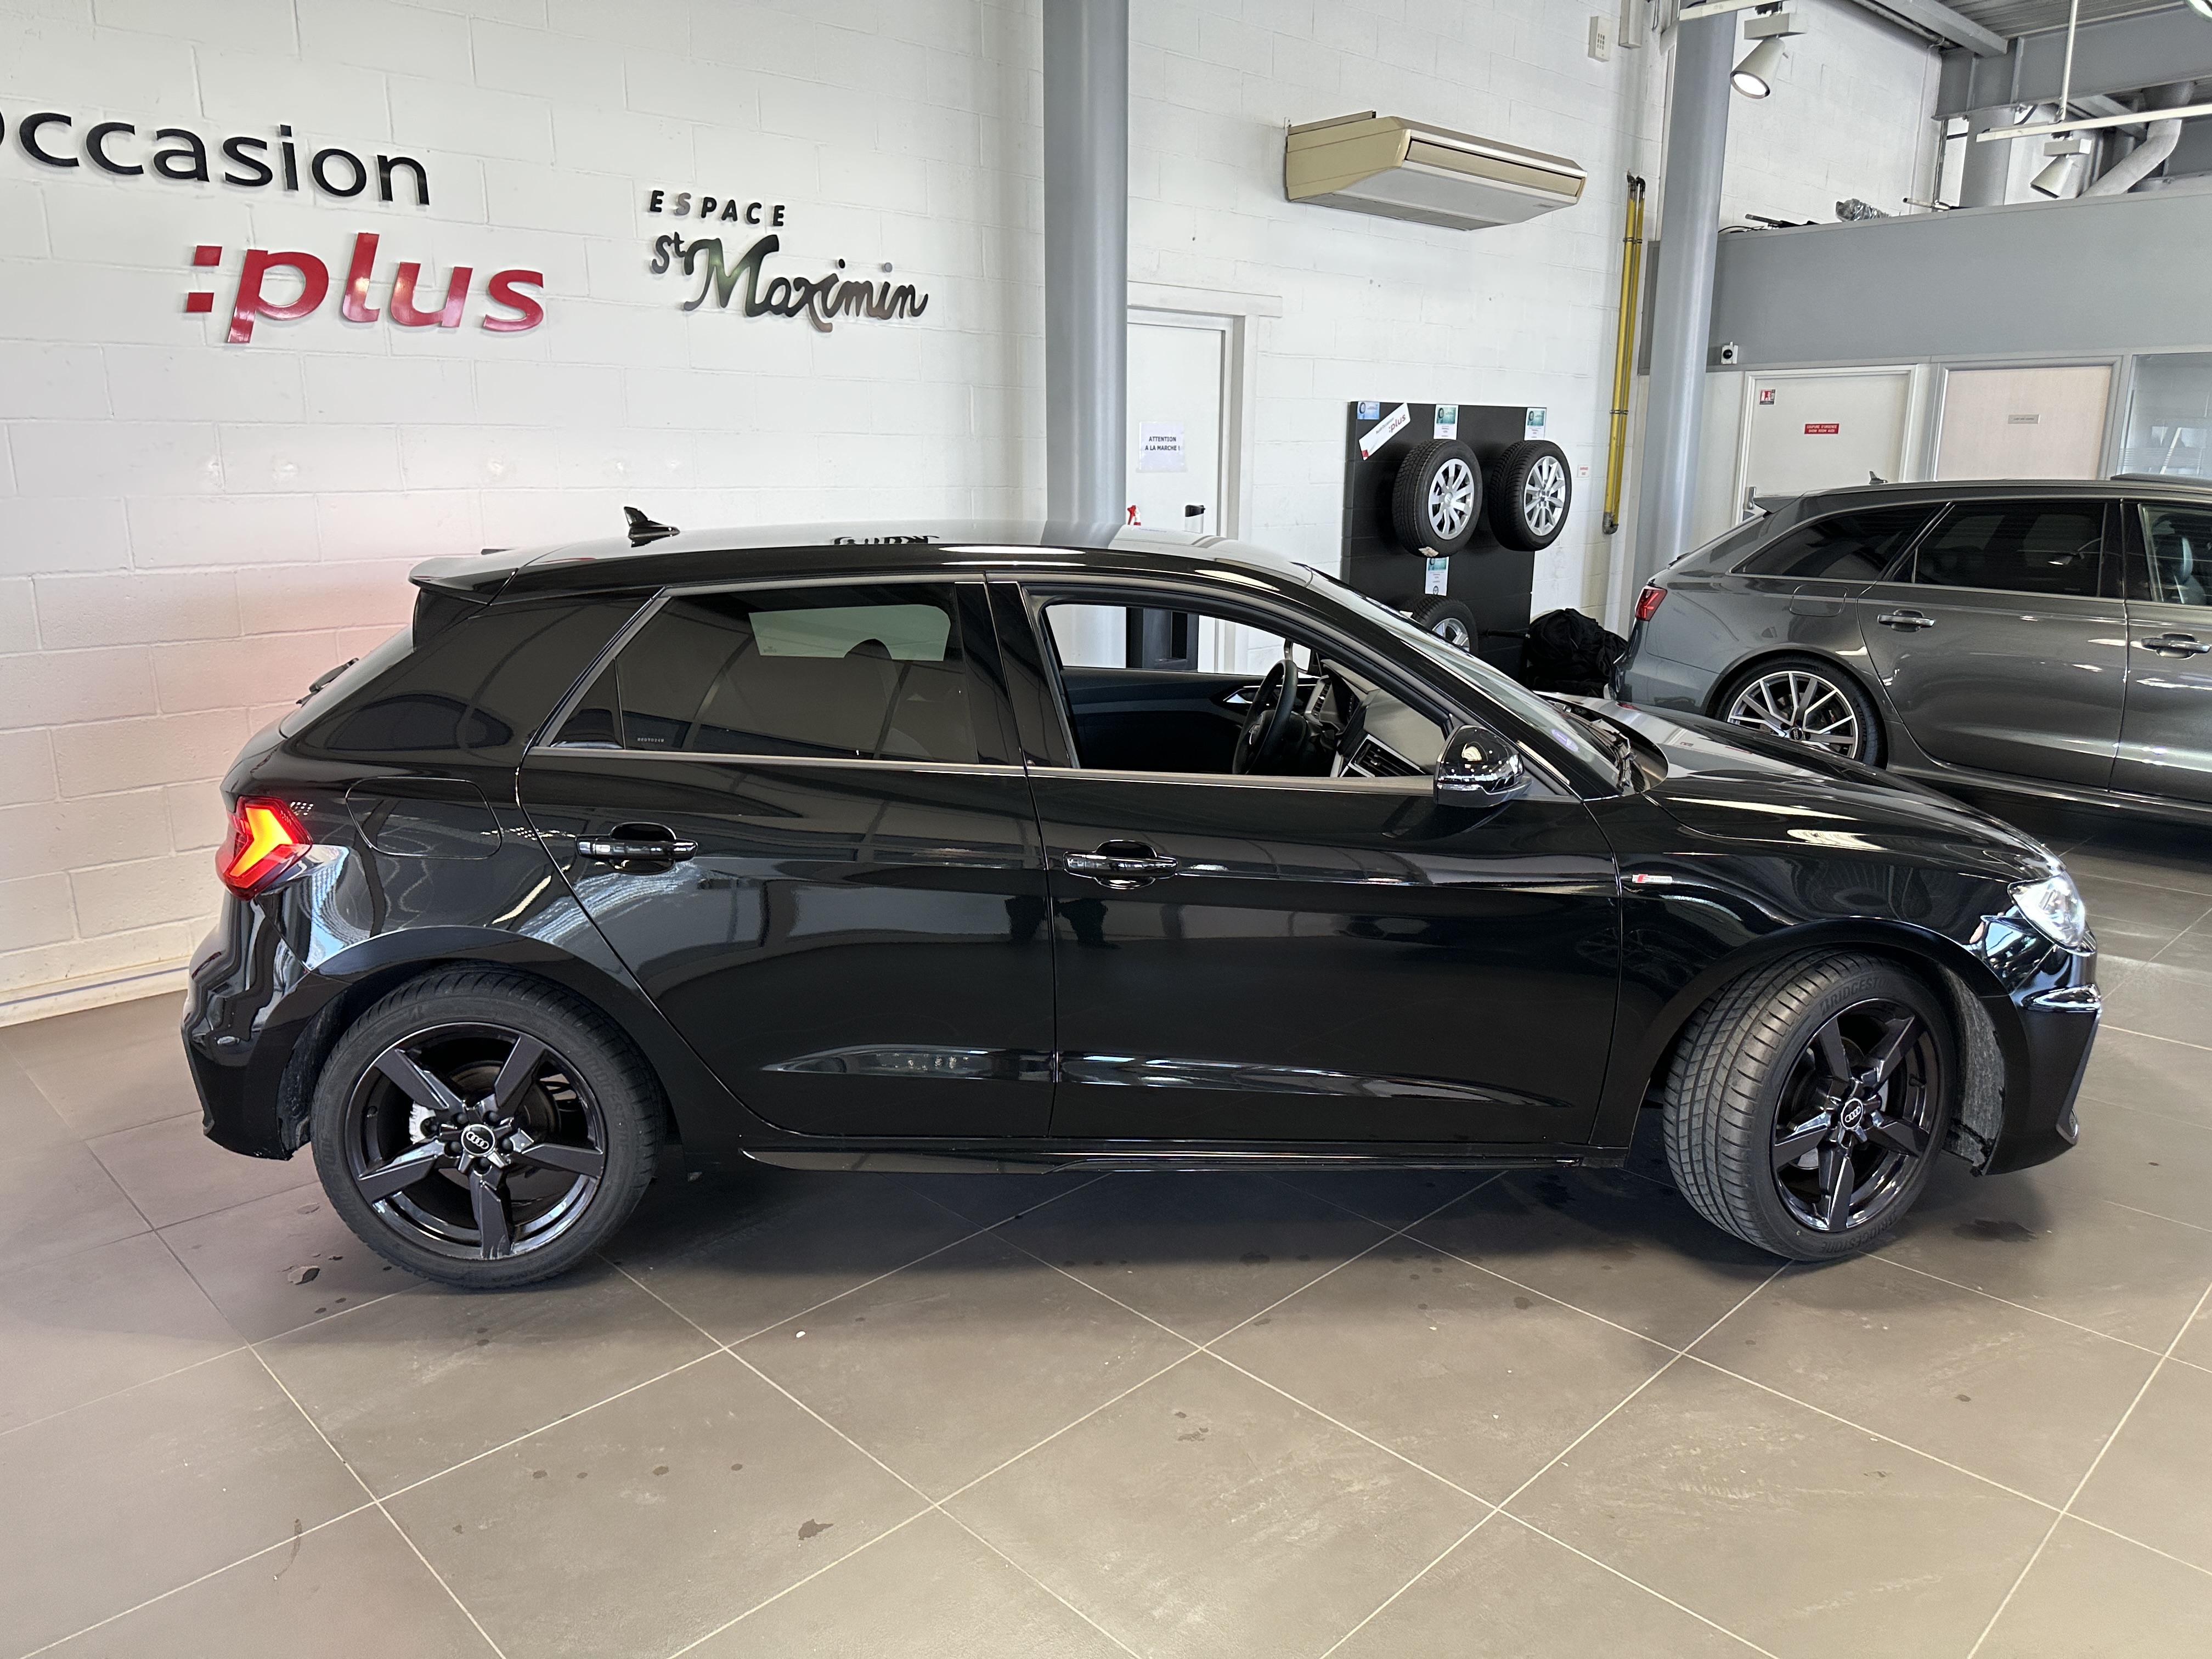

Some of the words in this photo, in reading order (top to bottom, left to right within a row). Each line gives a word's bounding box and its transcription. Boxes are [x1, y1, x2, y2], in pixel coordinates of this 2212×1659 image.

[0, 111, 430, 206] ccasion
[650, 190, 785, 227] ESPACE
[185, 232, 544, 343] :plus
[651, 232, 685, 274] St
[684, 234, 928, 332] Maximin
[1820, 975, 1893, 1015] BRIDGESTO
